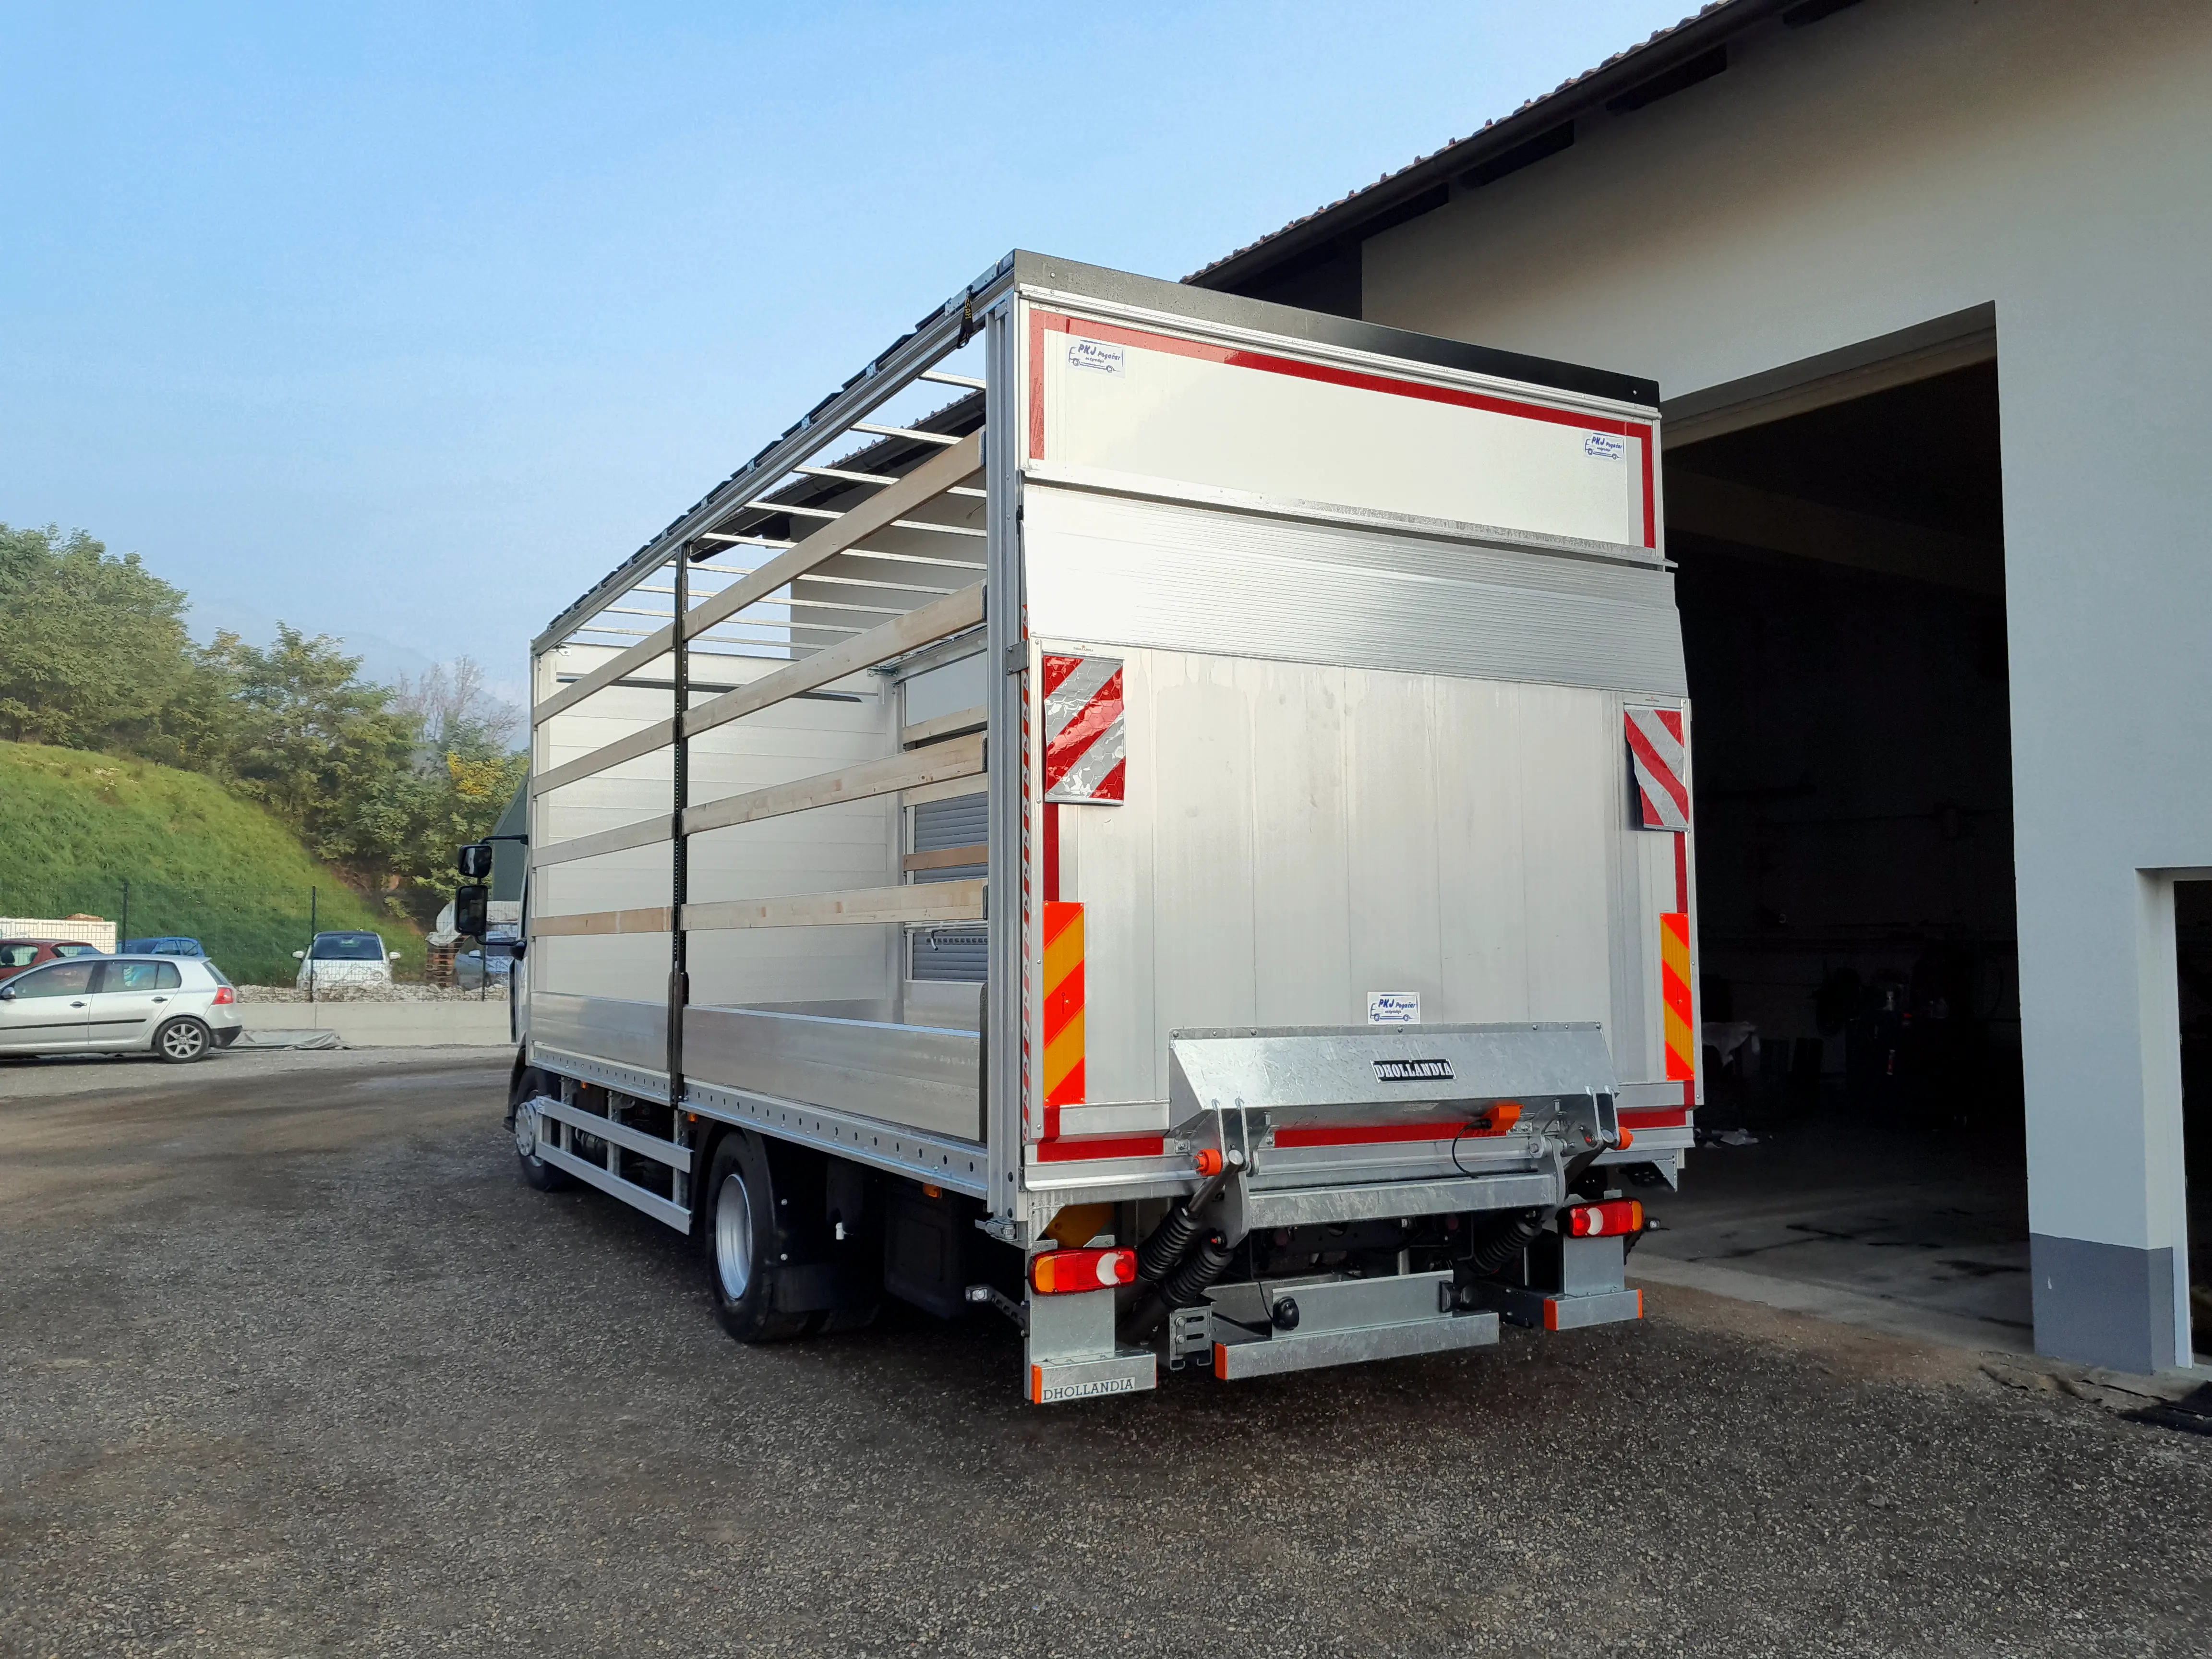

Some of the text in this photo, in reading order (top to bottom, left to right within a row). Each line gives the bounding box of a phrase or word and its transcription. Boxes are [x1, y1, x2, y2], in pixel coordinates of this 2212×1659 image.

[1078, 344, 1121, 361] PKJ Pogačar
[1591, 436, 1605, 445] PKJ
[1378, 998, 1416, 1010] PKJ Pogačar
[1373, 1062, 1454, 1078] DHOLLANDIA
[1043, 1379, 1133, 1400] DHOLLANDIA
